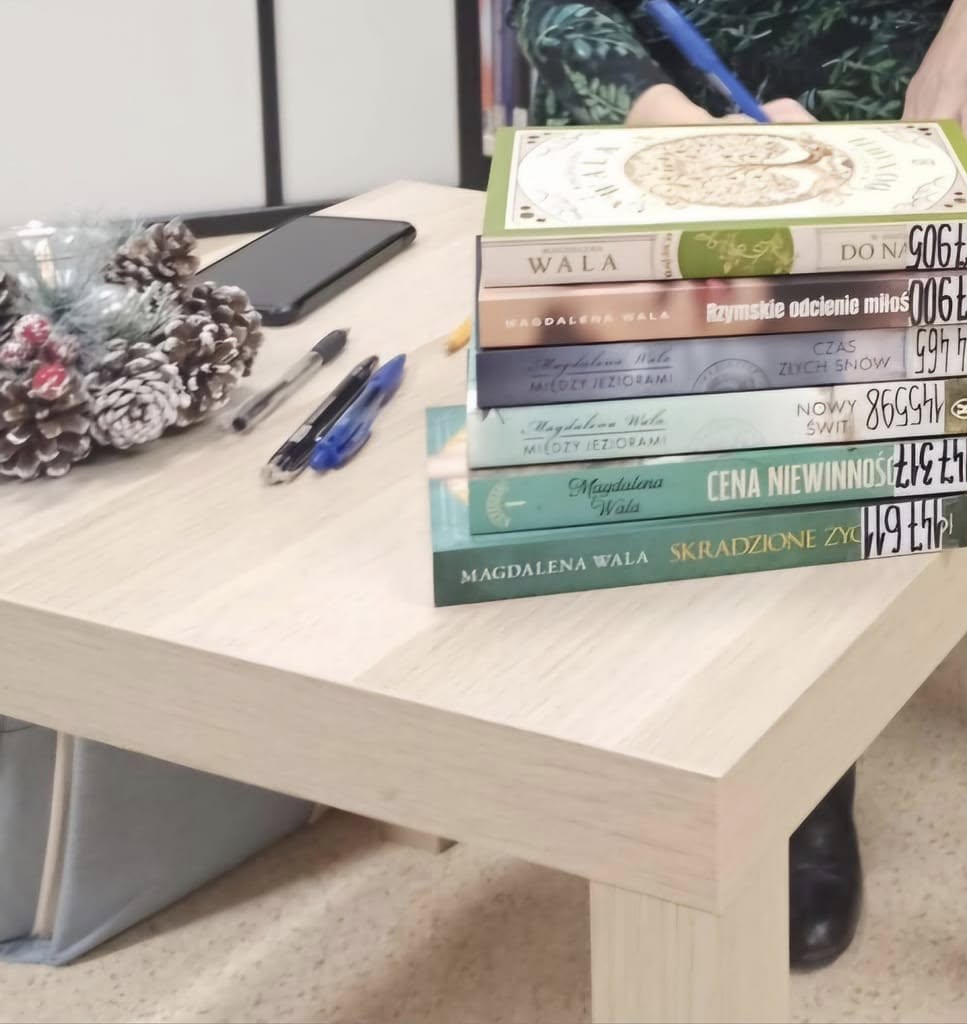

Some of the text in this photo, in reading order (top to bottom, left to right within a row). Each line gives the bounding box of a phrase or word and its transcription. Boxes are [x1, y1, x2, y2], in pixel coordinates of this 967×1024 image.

[841, 241, 908, 262] DO NA
[528, 253, 618, 275] WALA
[706, 290, 910, 324] Rzymskie odcienie miłoś
[504, 311, 671, 328] MAGDALENA WALA
[812, 339, 857, 356] CZAS
[796, 399, 857, 417] NOWY
[865, 383, 945, 431] 145598
[806, 419, 849, 436] ŚWIT
[568, 475, 664, 499] Magdalena
[706, 450, 896, 503] CENA NIEWINNOŚC
[590, 497, 641, 516] Wala
[669, 530, 817, 562] SKRADZIONE
[460, 550, 649, 585] MAGDALENA WALA
